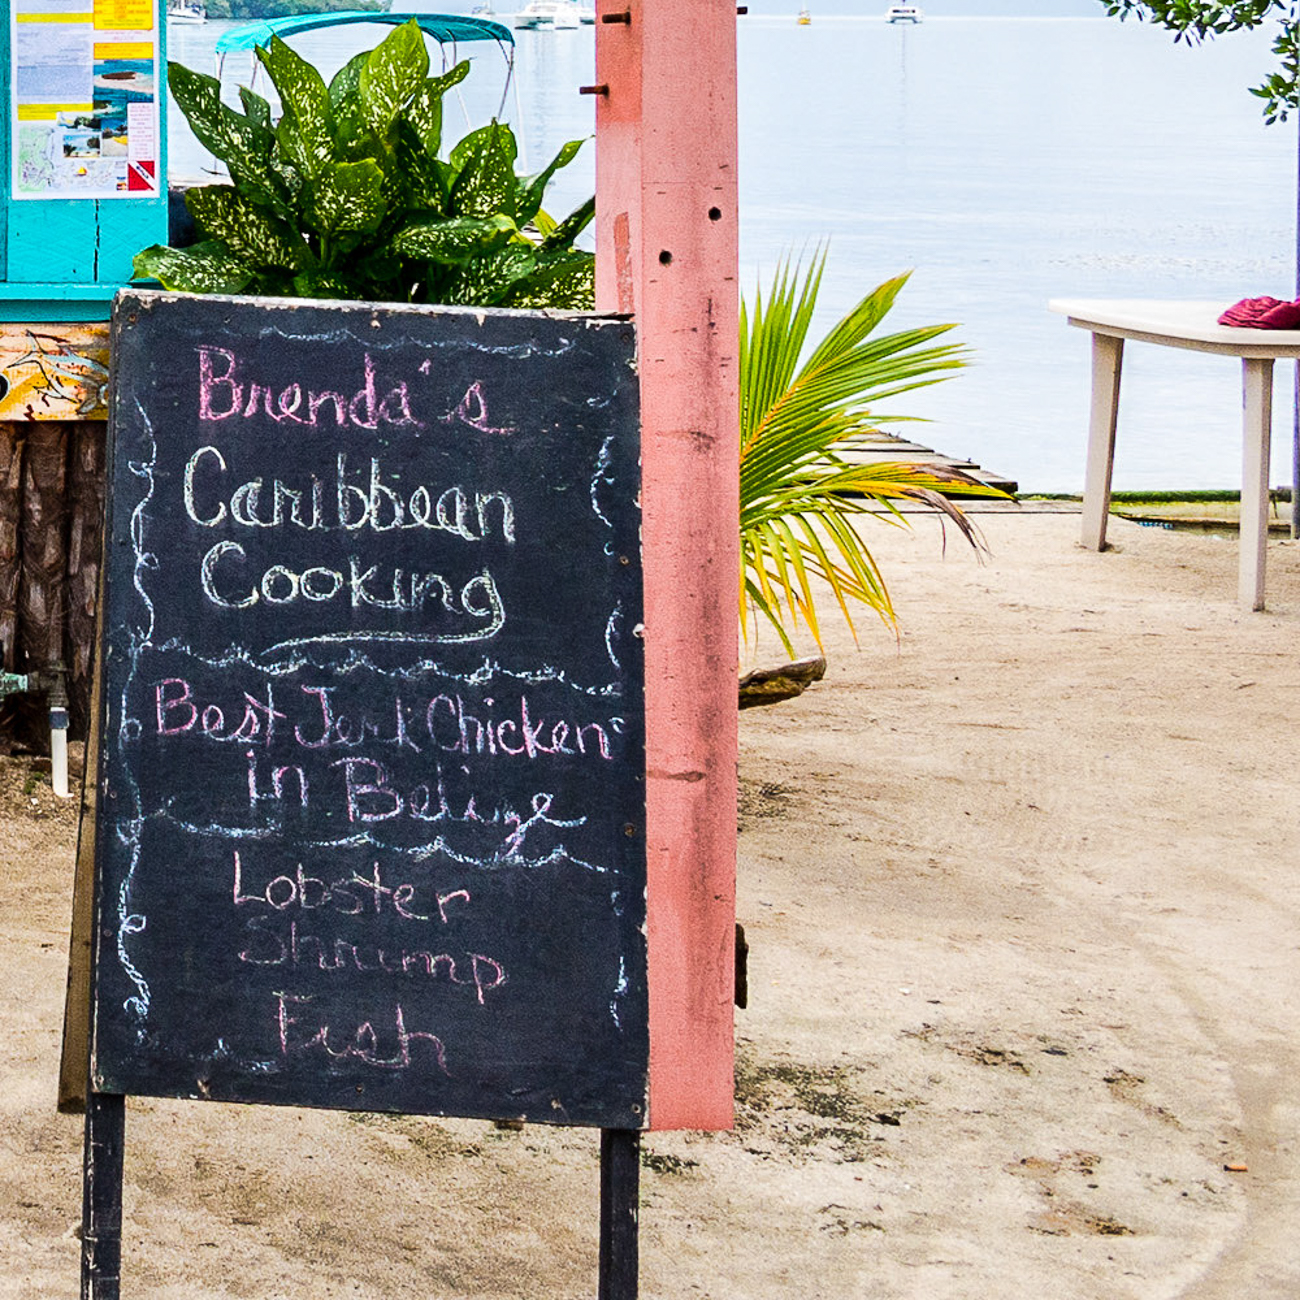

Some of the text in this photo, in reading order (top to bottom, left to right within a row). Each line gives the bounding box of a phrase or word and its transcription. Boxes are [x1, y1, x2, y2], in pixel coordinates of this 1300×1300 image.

[194, 345, 517, 435] Brenda's
[183, 446, 517, 543] Caribbean
[201, 540, 506, 645] Cooking
[156, 678, 613, 759] Best Jerk Chicken
[329, 756, 588, 850] Belize
[233, 851, 470, 924] Lobster
[239, 916, 507, 1005] Shrimp
[273, 992, 453, 1078] Fish
